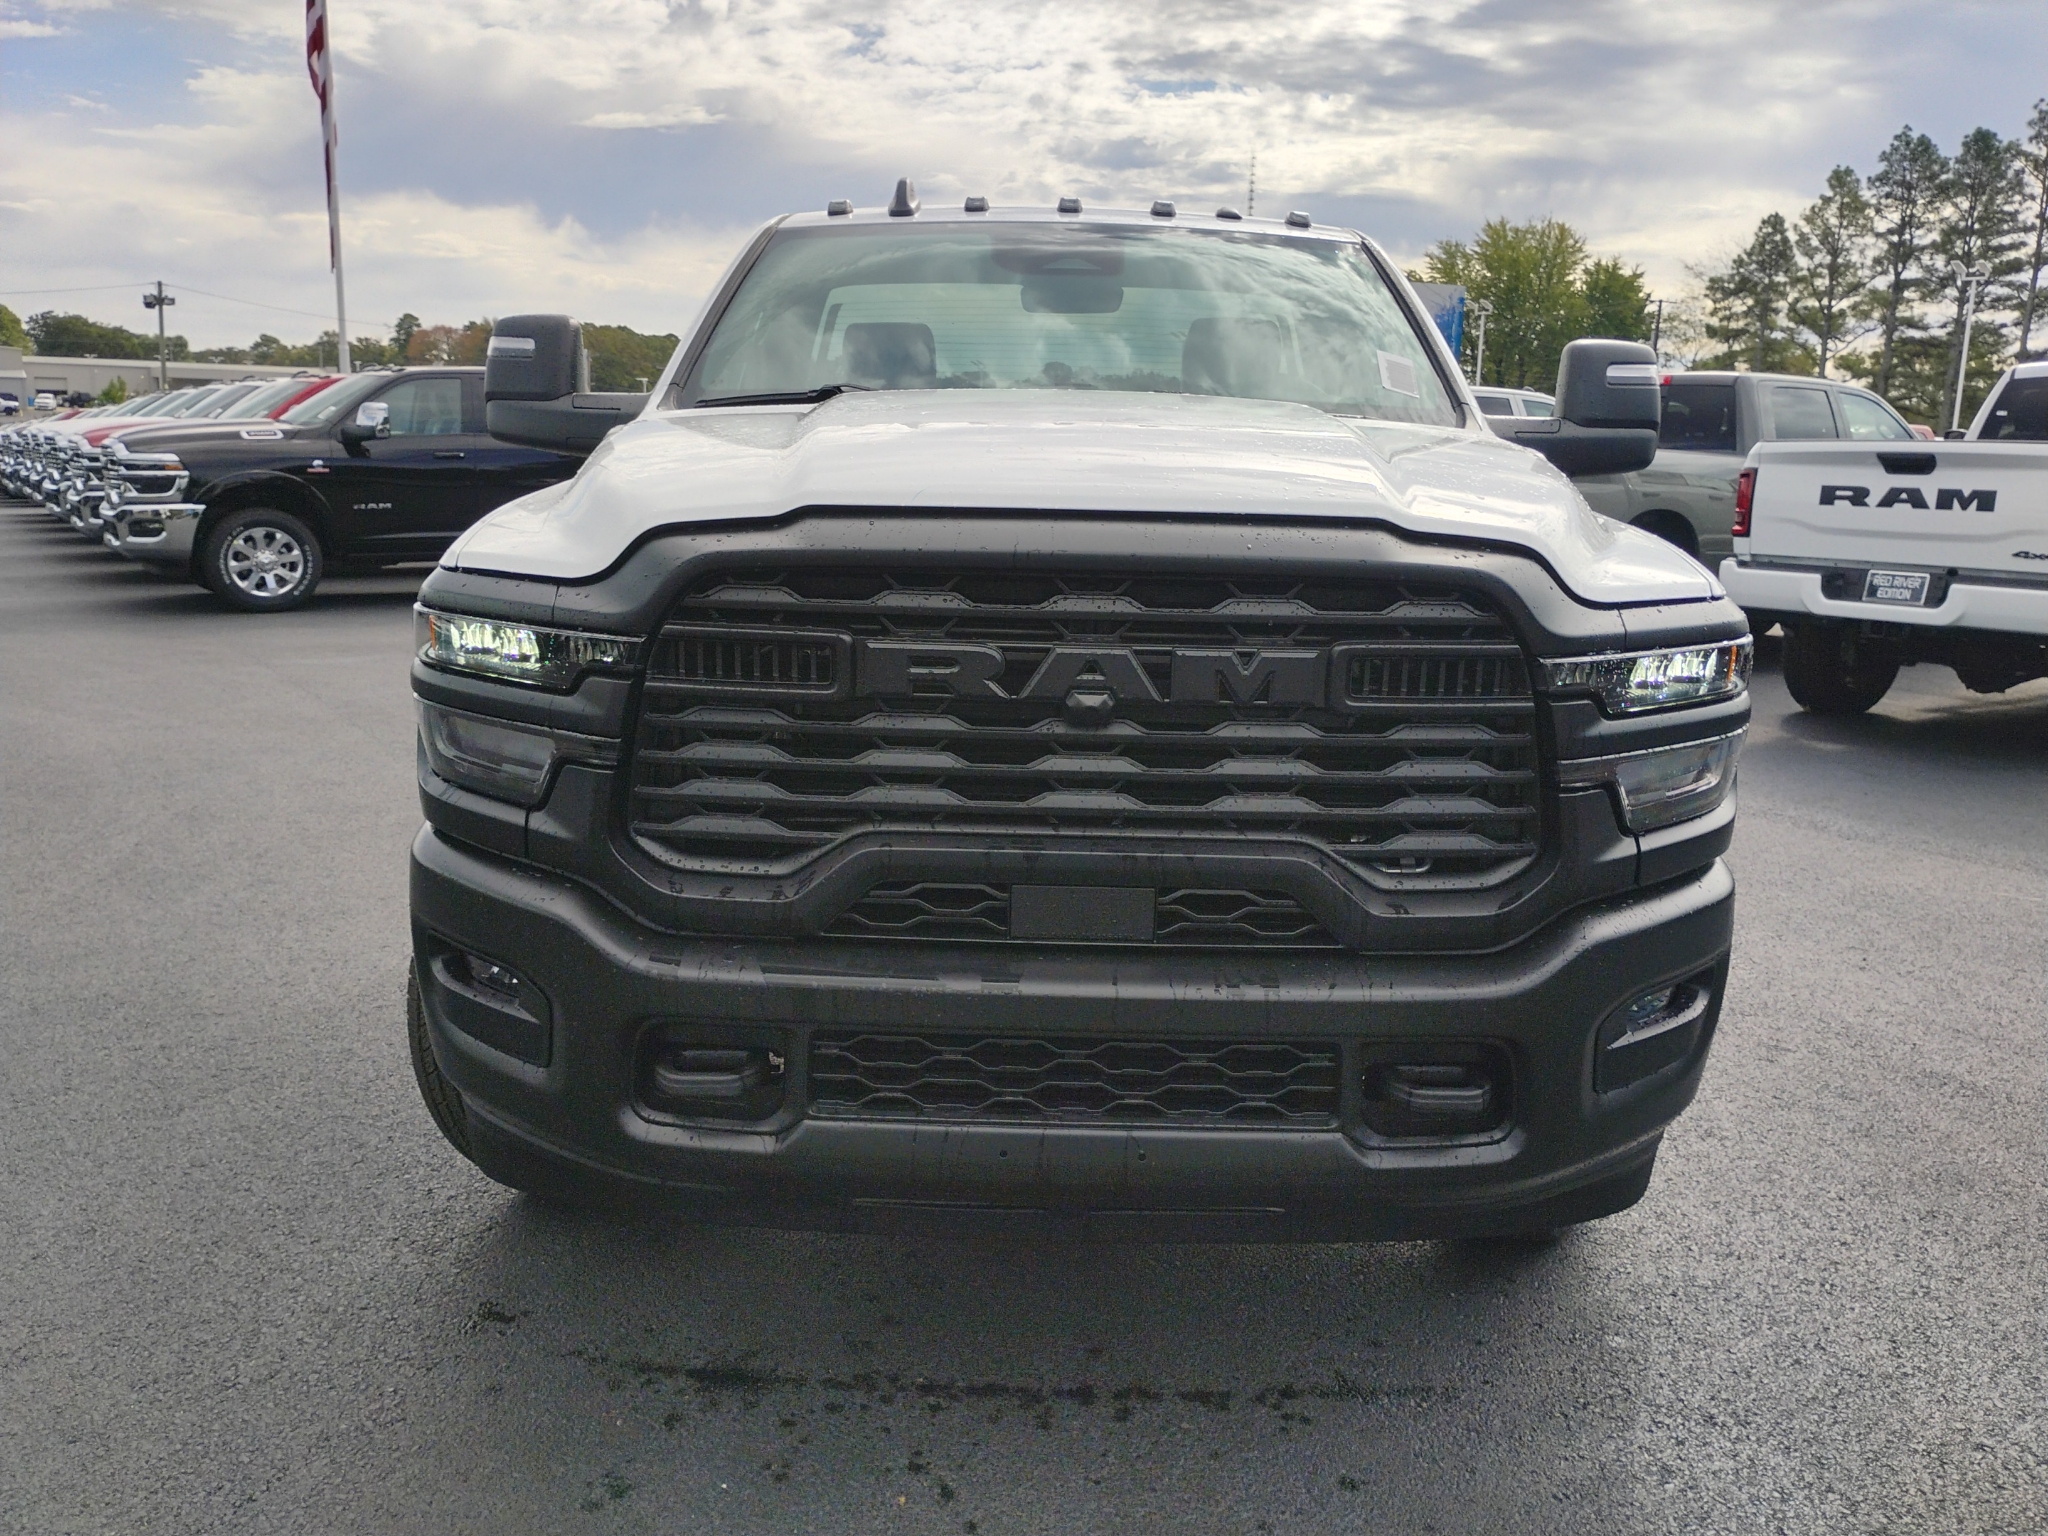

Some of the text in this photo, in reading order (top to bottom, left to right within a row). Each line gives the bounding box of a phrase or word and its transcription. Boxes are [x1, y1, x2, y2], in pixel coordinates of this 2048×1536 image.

[1818, 485, 1998, 512] RAM
[353, 502, 392, 510] RAM
[2011, 550, 2048, 561] 4x
[1872, 574, 1921, 589] RED RIVER
[1876, 587, 1912, 600] EDITION
[858, 639, 1328, 706] RAM
